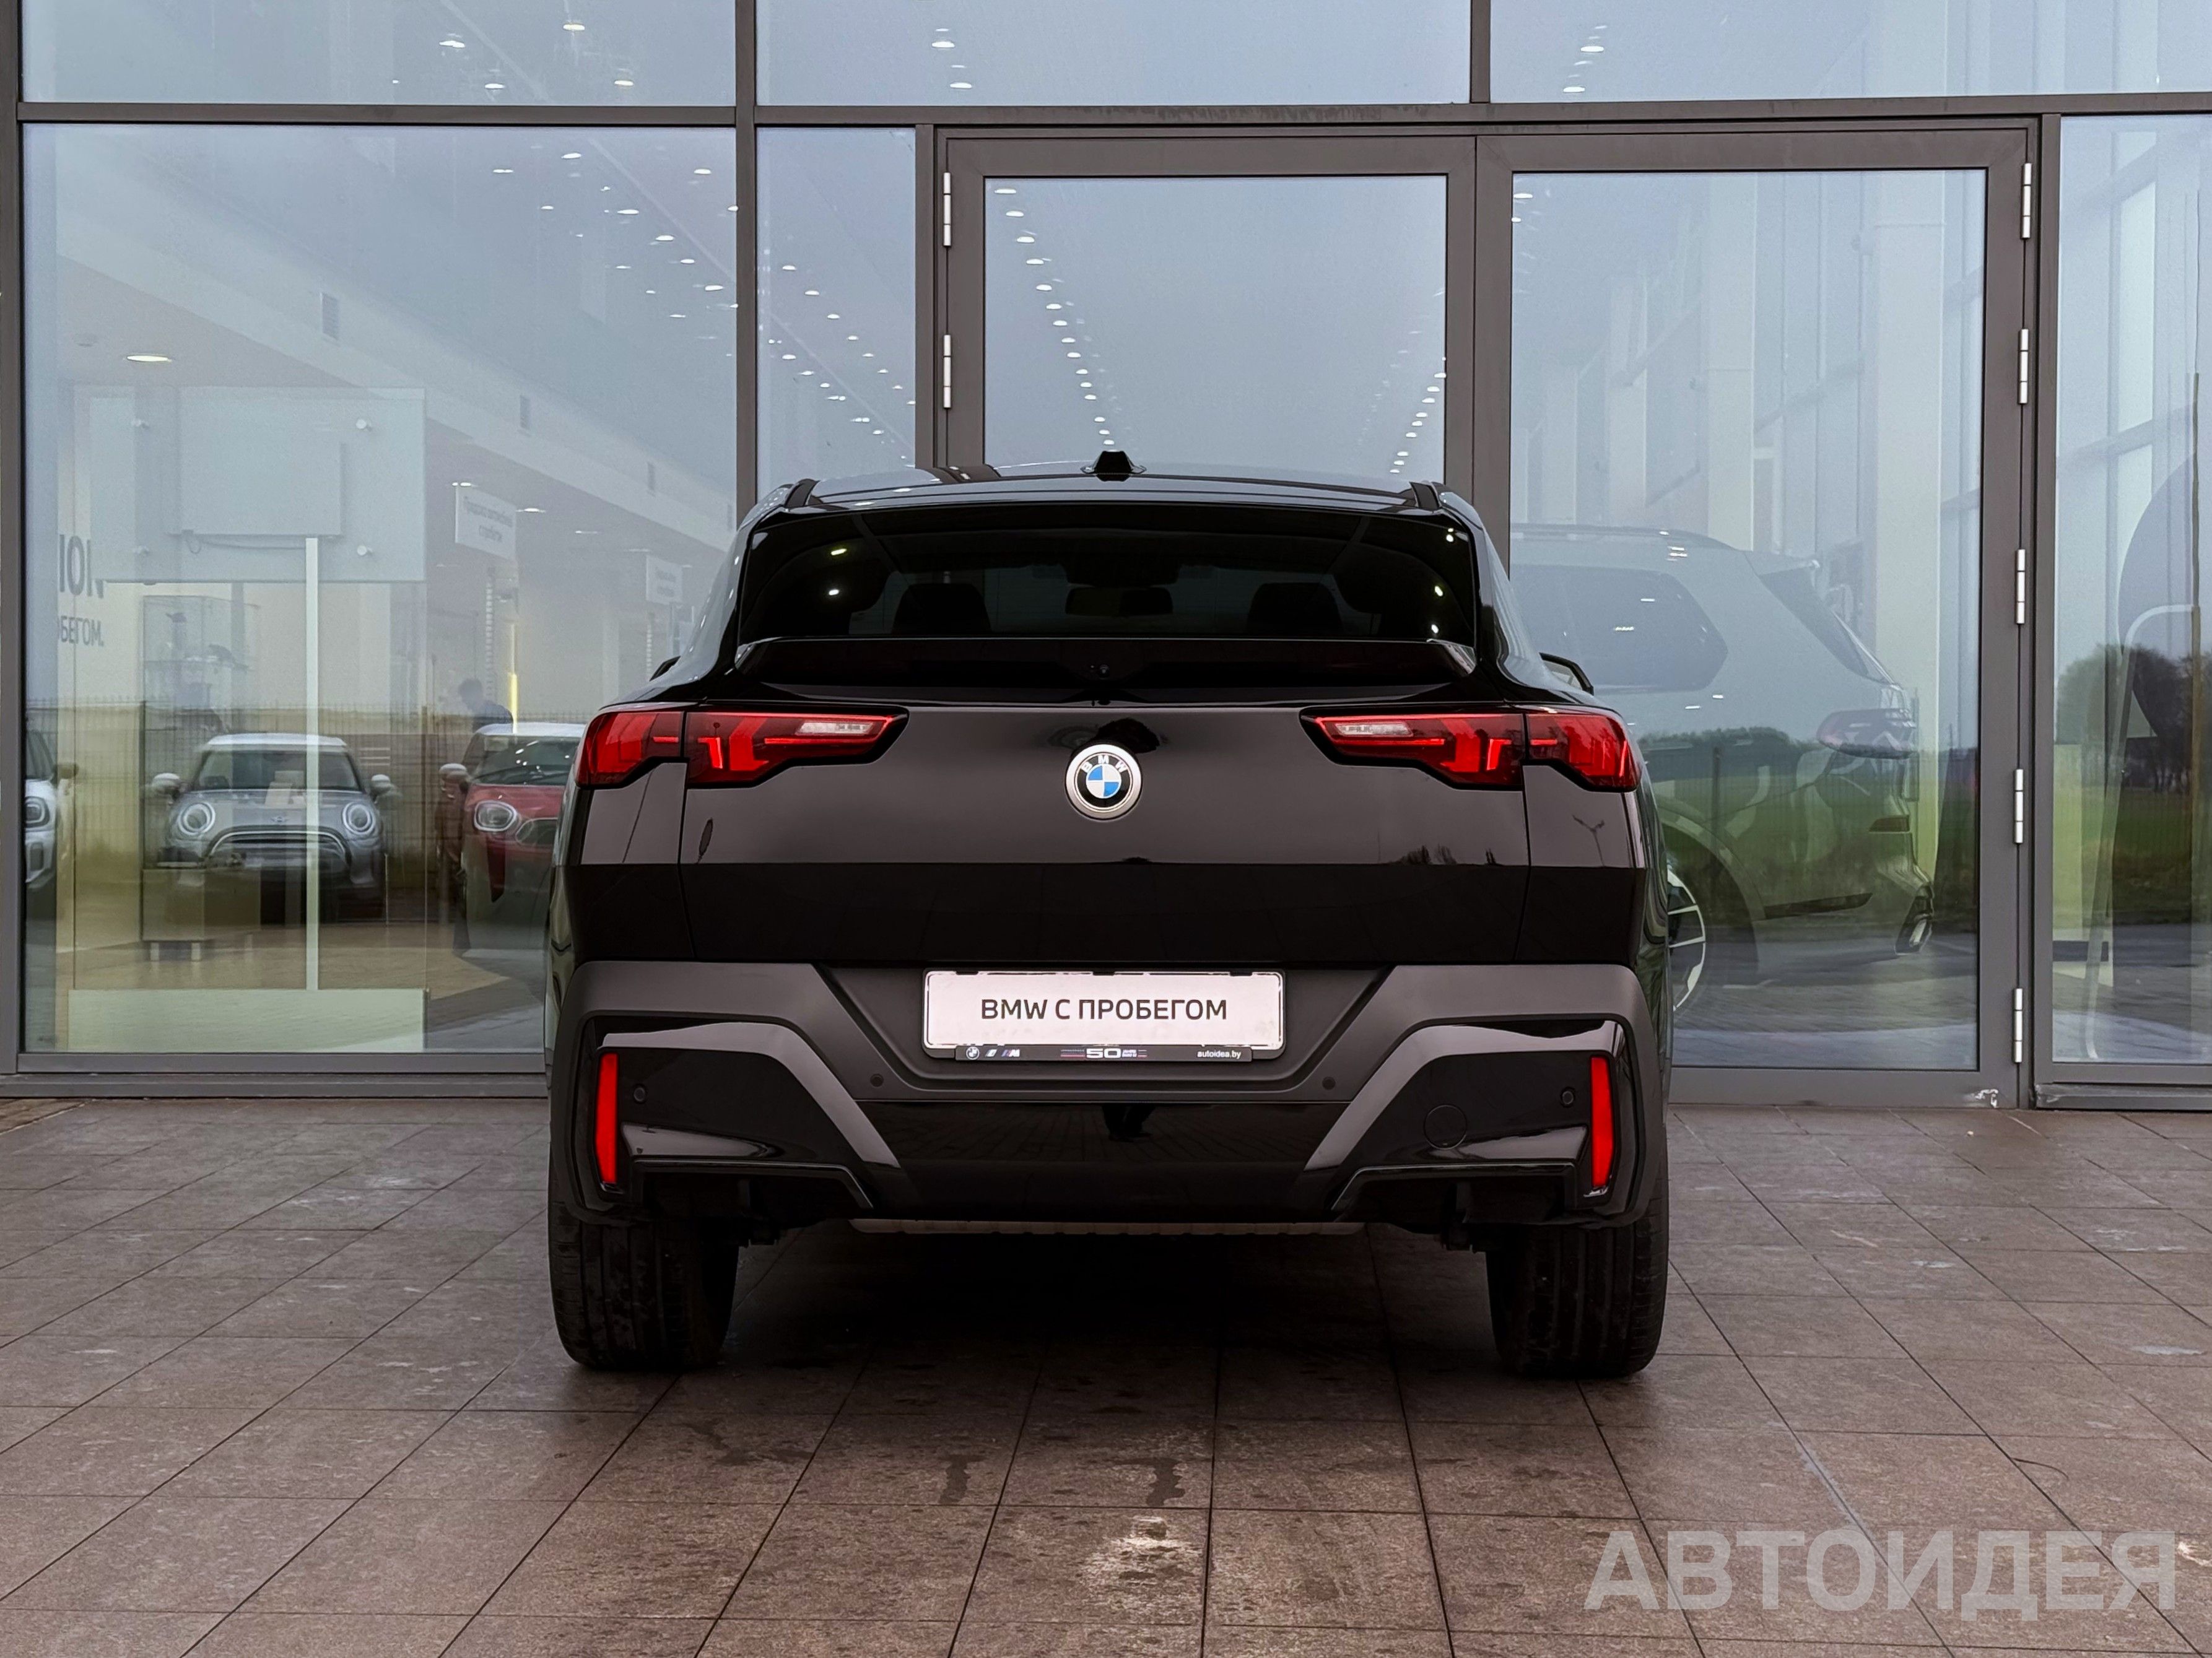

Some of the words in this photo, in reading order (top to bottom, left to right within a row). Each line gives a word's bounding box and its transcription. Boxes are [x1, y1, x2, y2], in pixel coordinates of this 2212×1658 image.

[1080, 754, 1128, 773] BMW
[982, 999, 1048, 1020] BMW
[1055, 999, 1071, 1020] С
[1078, 999, 1227, 1020] ПРОБЕГОМ
[1086, 1048, 1121, 1059] 50
[1197, 1049, 1242, 1059] autoidea.by
